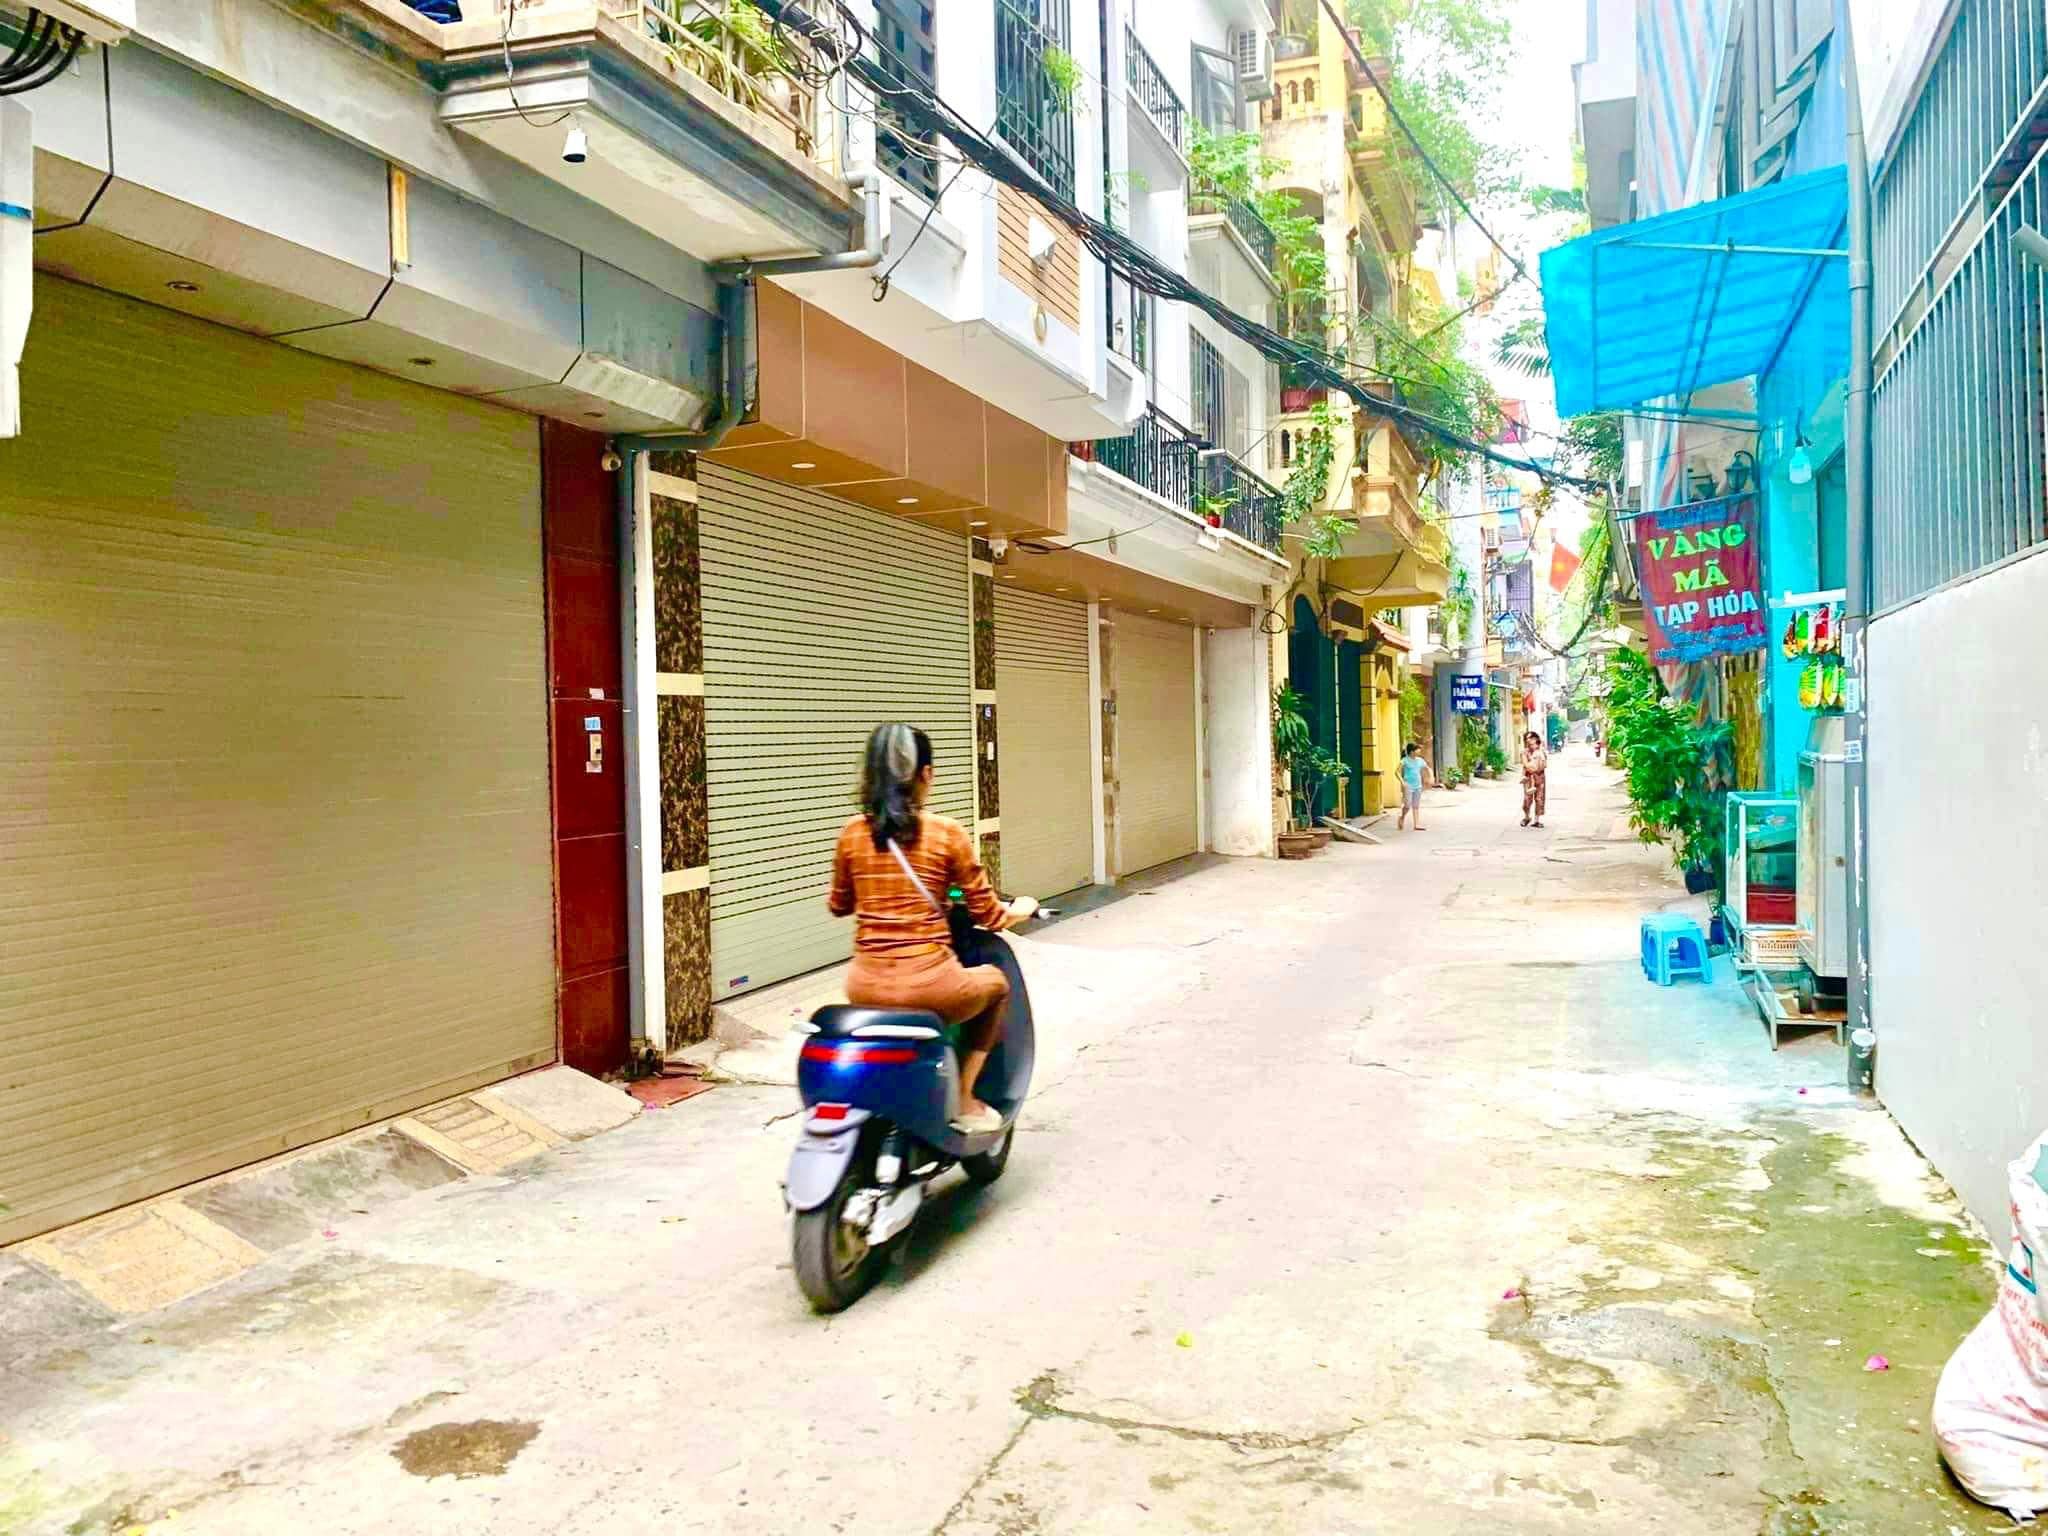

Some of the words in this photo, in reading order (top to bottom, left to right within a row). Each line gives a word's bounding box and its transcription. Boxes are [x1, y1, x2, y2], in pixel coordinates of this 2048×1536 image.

[1647, 524, 1746, 560] VÀNG
[1672, 559, 1729, 593] MÃ
[1653, 601, 1699, 629] TẠP
[1707, 590, 1759, 619] HÓA
